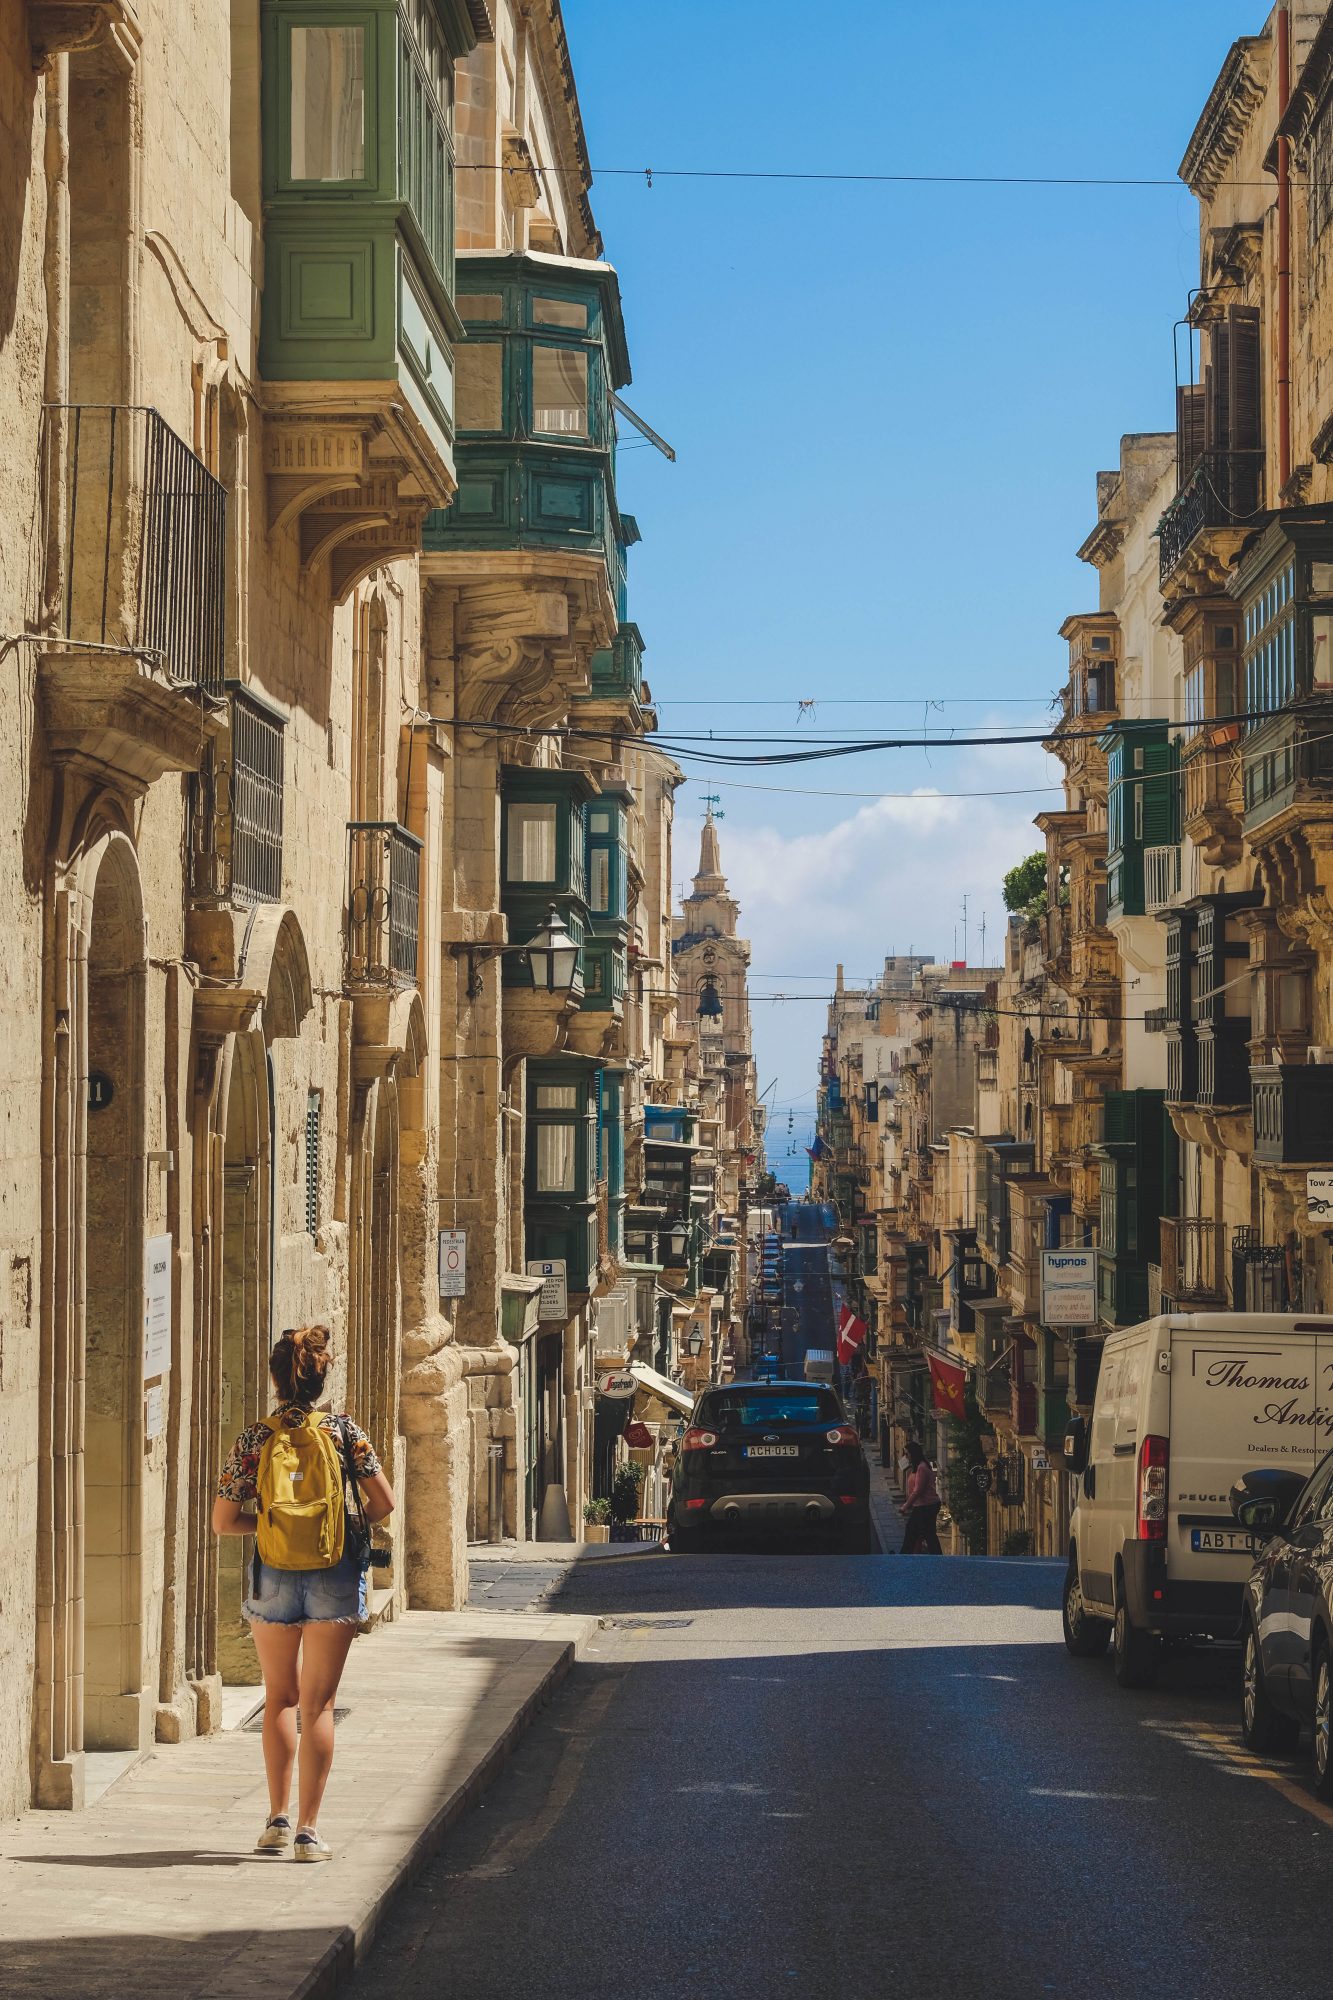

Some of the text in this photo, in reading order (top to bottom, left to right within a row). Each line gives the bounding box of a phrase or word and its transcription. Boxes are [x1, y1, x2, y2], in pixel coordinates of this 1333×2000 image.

[1048, 1256, 1087, 1268] hypnos
[1205, 1360, 1310, 1390] Thomas
[1247, 1443, 1329, 1454] Dealers & Restorers
[1178, 1493, 1231, 1502] PEUGE
